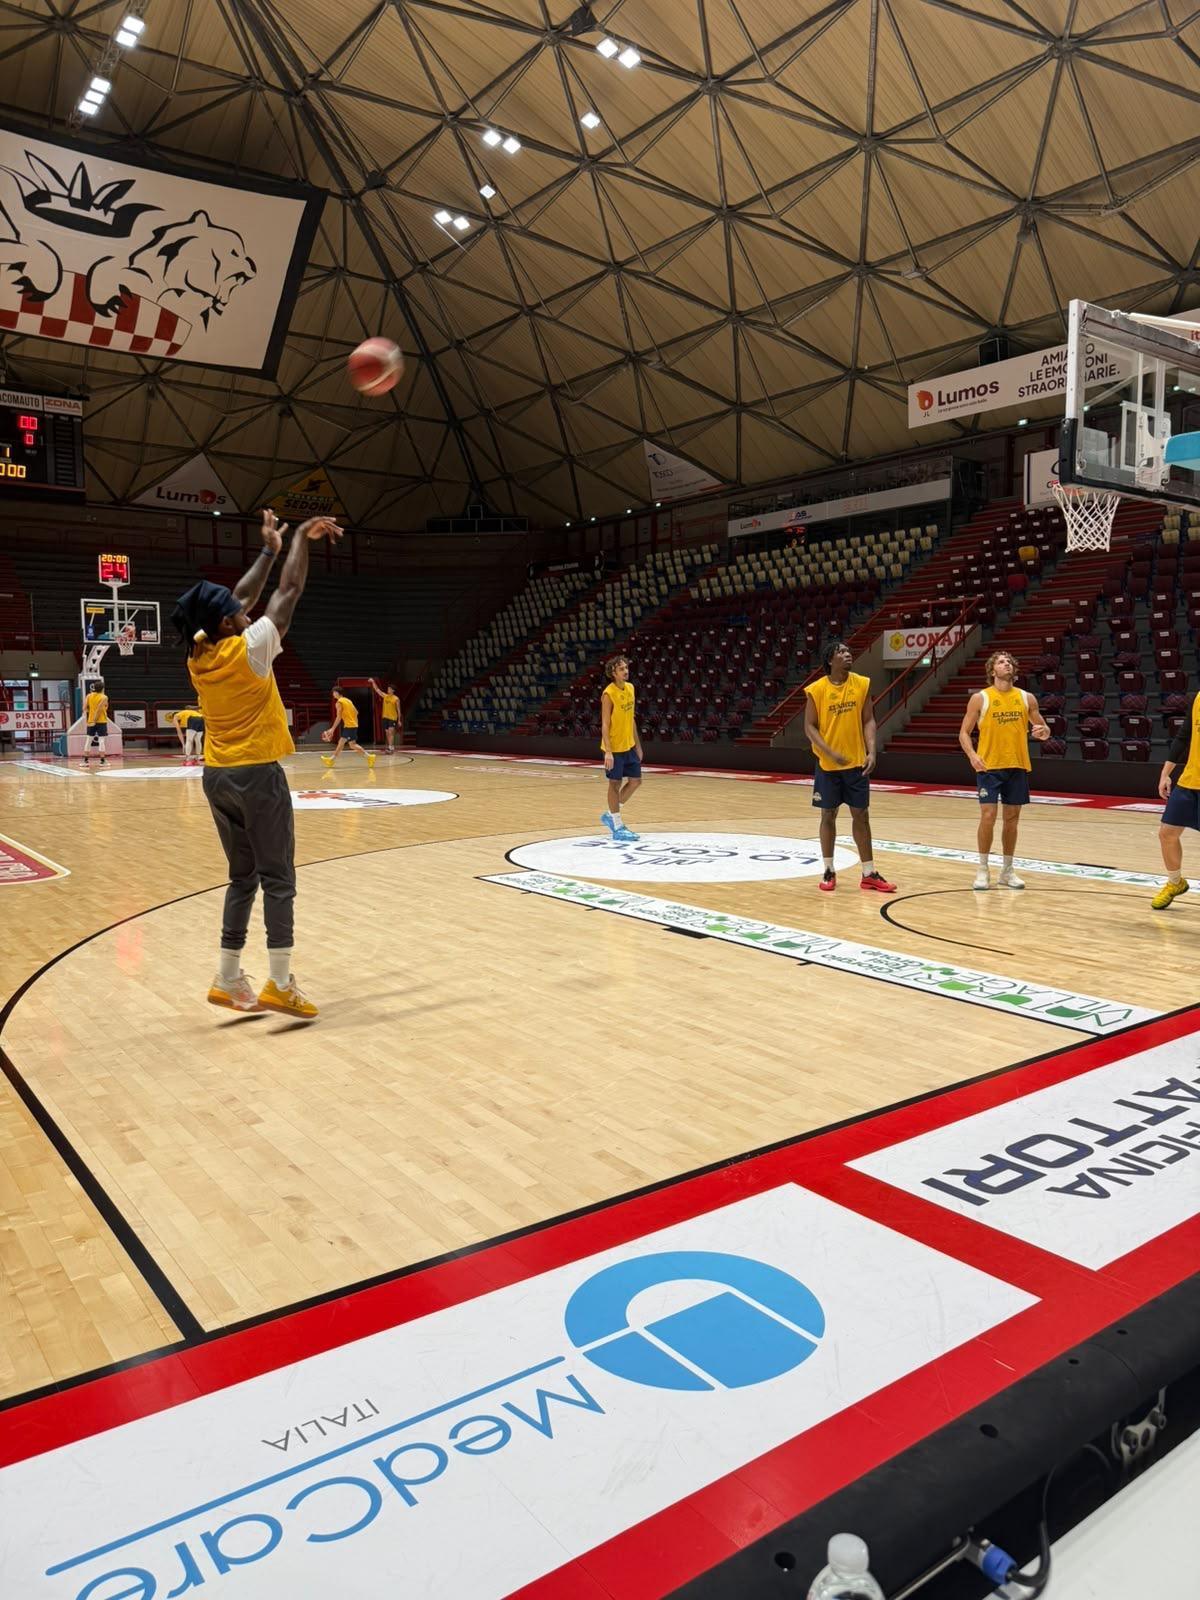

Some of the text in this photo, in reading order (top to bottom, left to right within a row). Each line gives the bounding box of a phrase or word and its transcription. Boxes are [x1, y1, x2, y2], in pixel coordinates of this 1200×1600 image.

[0, 392, 40, 407] COMAUTO
[937, 381, 1000, 406] Lumos
[45, 398, 81, 409] ZONA
[156, 486, 227, 505] Lumos
[101, 553, 128, 563] 20:00
[102, 562, 127, 579] 24
[15, 712, 55, 720] PISTOIA
[15, 721, 56, 729] BASKET
[921, 1070, 1200, 1207] ATTORI
[262, 1398, 380, 1451] ITALIA
